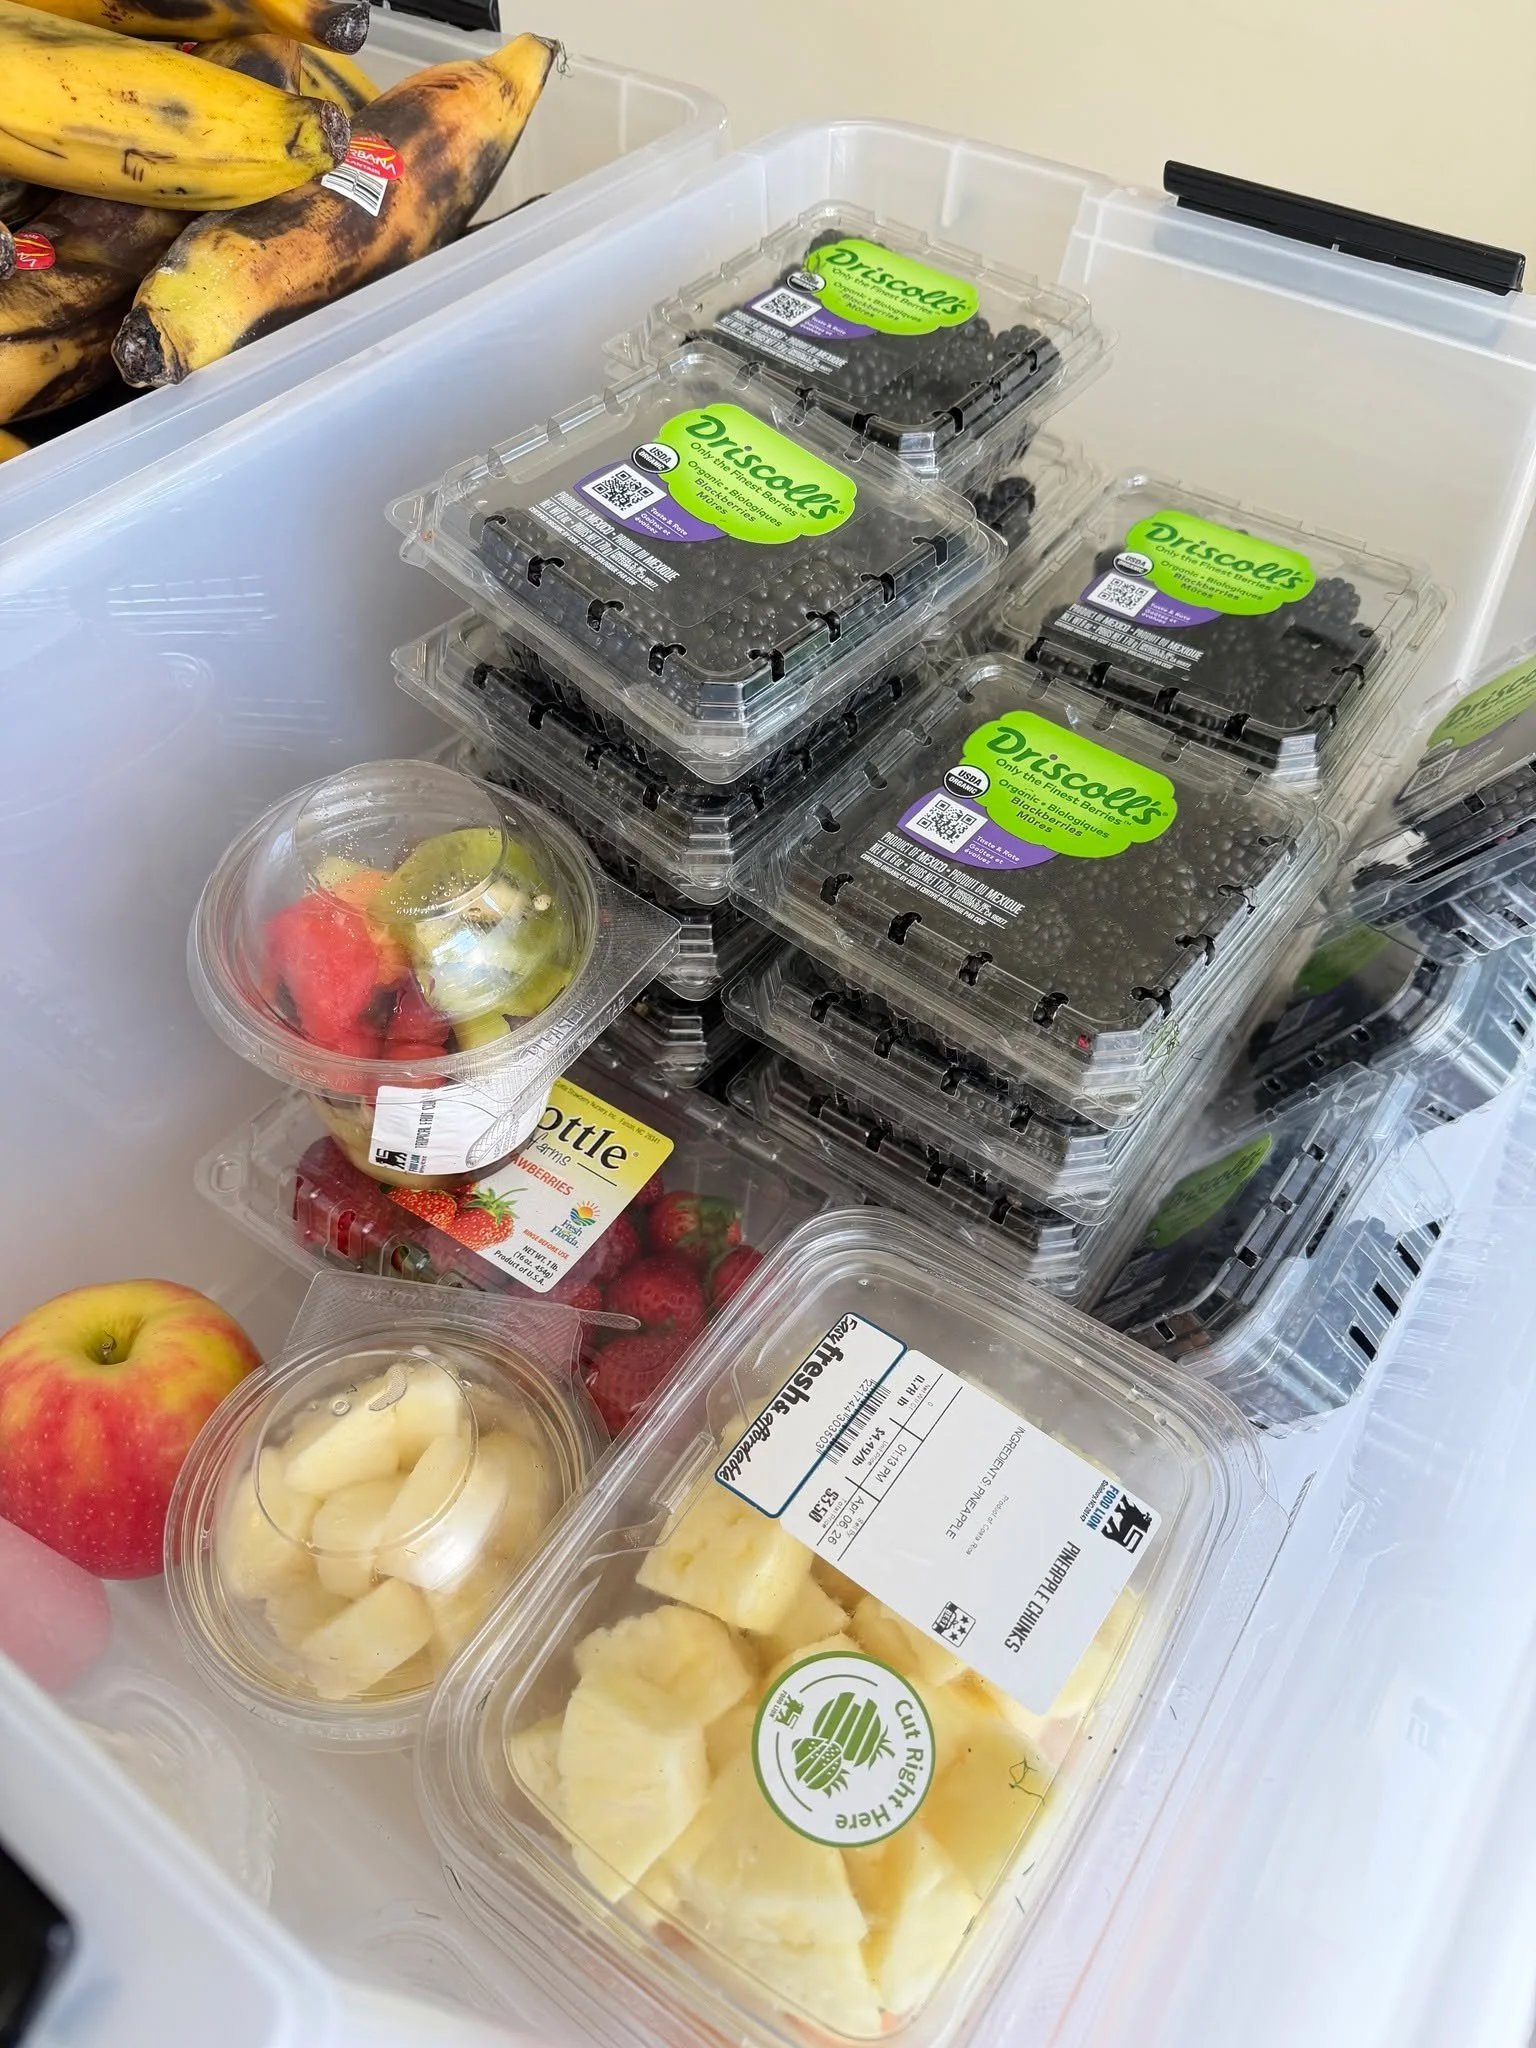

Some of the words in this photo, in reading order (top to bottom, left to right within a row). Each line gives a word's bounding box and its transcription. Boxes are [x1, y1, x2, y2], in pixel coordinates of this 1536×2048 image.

[349, 149, 397, 175] RBANA
[649, 446, 671, 463] USDA
[690, 442, 713, 459] Only
[712, 458, 730, 471] the
[729, 469, 762, 493] Finest
[554, 490, 585, 512] PRODUCT
[687, 460, 723, 487] Organic
[728, 489, 782, 526] Biologiques
[694, 477, 756, 522] Blackberries
[577, 508, 592, 517] OF
[583, 513, 614, 534] MEXICO
[650, 507, 666, 520] Taste
[672, 523, 687, 535] Rate
[611, 533, 642, 553] PRODUIT
[634, 549, 649, 559] DU
[642, 555, 680, 581] MEXIQUE
[1124, 555, 1146, 567] USDA
[1155, 545, 1179, 557] Only
[1180, 554, 1197, 563] the
[1199, 561, 1232, 576] Finest
[1160, 559, 1198, 577] Organic
[1206, 576, 1264, 600] Biologiques
[1173, 572, 1239, 600] Blackberries
[948, 775, 977, 794] ORGANIC
[957, 769, 981, 786] USDA
[995, 758, 1022, 775] Only
[1022, 772, 1041, 785] the
[1042, 782, 1079, 804] Finest
[998, 778, 1040, 803] Organic
[1046, 803, 1109, 838] Biologiques
[1010, 796, 1083, 836] Blackberries
[868, 842, 885, 855] NET
[880, 848, 895, 860] WT
[889, 853, 899, 863] 6
[964, 848, 990, 864] évaluez
[968, 843, 994, 859] Goûtez
[976, 835, 995, 848] Taste
[1002, 849, 1019, 861] Rate
[880, 831, 913, 853] PRODUCT
[907, 846, 921, 857] OF
[915, 851, 948, 872] MEXICO
[947, 868, 980, 889] PRODUIT
[974, 883, 989, 895] DU
[984, 888, 1025, 914] MEXIQUE
[893, 858, 904, 867] oz
[904, 862, 927, 878] POIDS
[921, 872, 938, 885] NET
[933, 878, 949, 891] 170
[942, 885, 952, 894] g
[537, 1106, 622, 1169] ottle
[510, 1153, 574, 1196] AWBERRIES
[560, 1219, 582, 1236] Fresh
[523, 1228, 539, 1240] RINSE
[537, 1238, 558, 1253] BEFORE
[557, 1250, 569, 1259] USE
[493, 1249, 519, 1268] Product
[526, 1270, 544, 1286] U.S.A.
[512, 1251, 525, 1260] (16
[523, 1258, 533, 1267] oz.
[534, 1264, 553, 1279] 454g)
[522, 1245, 536, 1255] NET
[534, 1252, 546, 1263] WT.
[549, 1262, 559, 1271] lb.
[825, 1315, 857, 1344] Easy
[780, 1342, 843, 1404] fresh
[905, 1374, 925, 1395] 0.78
[770, 1398, 791, 1416] &
[843, 1378, 873, 1412] 221744
[896, 1396, 909, 1406] lb
[815, 1413, 845, 1448] 303503
[719, 1412, 773, 1481] affordable
[851, 1427, 885, 1466] $4.49/lb
[875, 1465, 891, 1482] PM
[808, 1487, 839, 1523] $3.50
[847, 1494, 865, 1515] Apr
[1099, 1484, 1119, 1509] FOOD
[835, 1513, 853, 1530] 06,
[945, 1485, 985, 1539] PINEAPPLE
[1086, 1507, 1105, 1530] LION
[827, 1529, 841, 1544] 26
[1034, 1540, 1080, 1603] PINEAPPLE
[1004, 1600, 1043, 1652] CHUNKS
[894, 1699, 921, 1740] Cut
[888, 1747, 924, 1808] Right
[835, 1804, 892, 1829] Here
